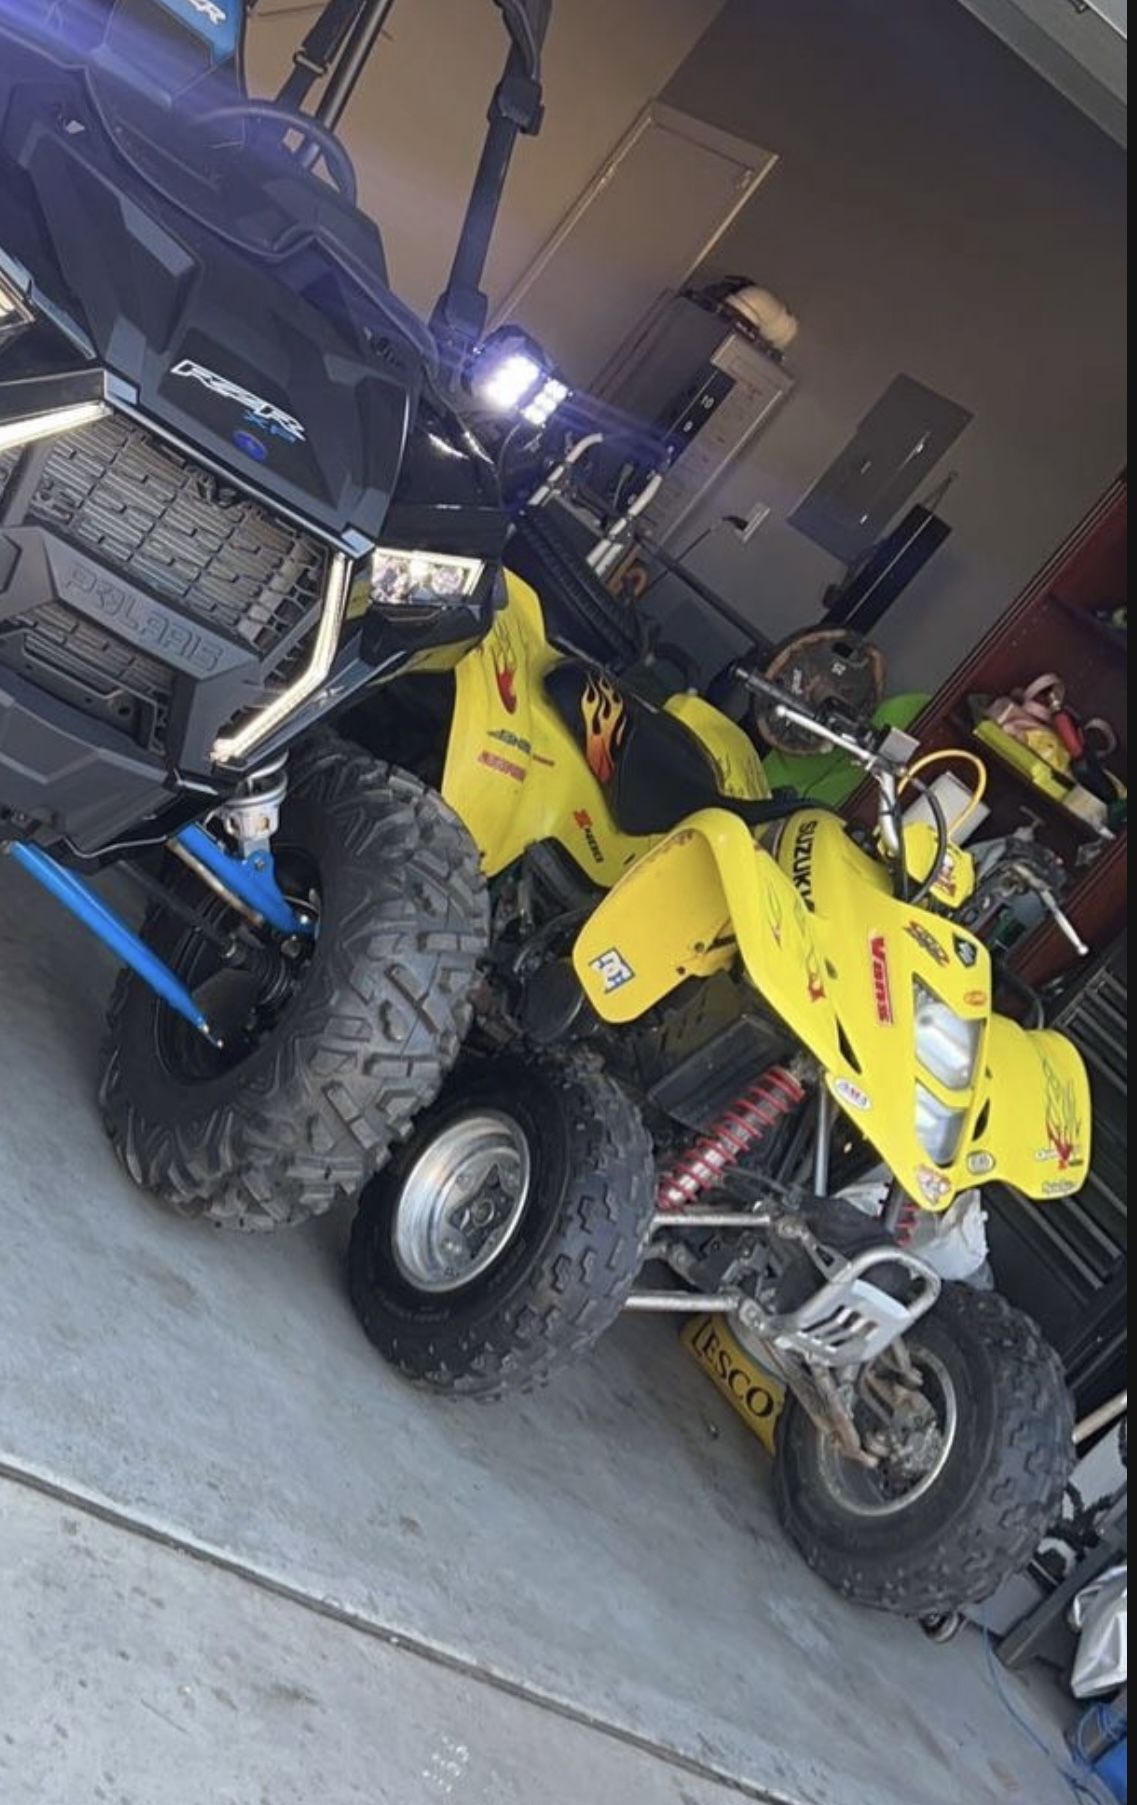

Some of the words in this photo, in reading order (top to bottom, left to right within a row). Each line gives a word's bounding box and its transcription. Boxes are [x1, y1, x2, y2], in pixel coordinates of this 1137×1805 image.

[170, 358, 306, 442] RZR
[66, 563, 224, 672] POLARIS
[692, 1316, 775, 1419] LESCO
